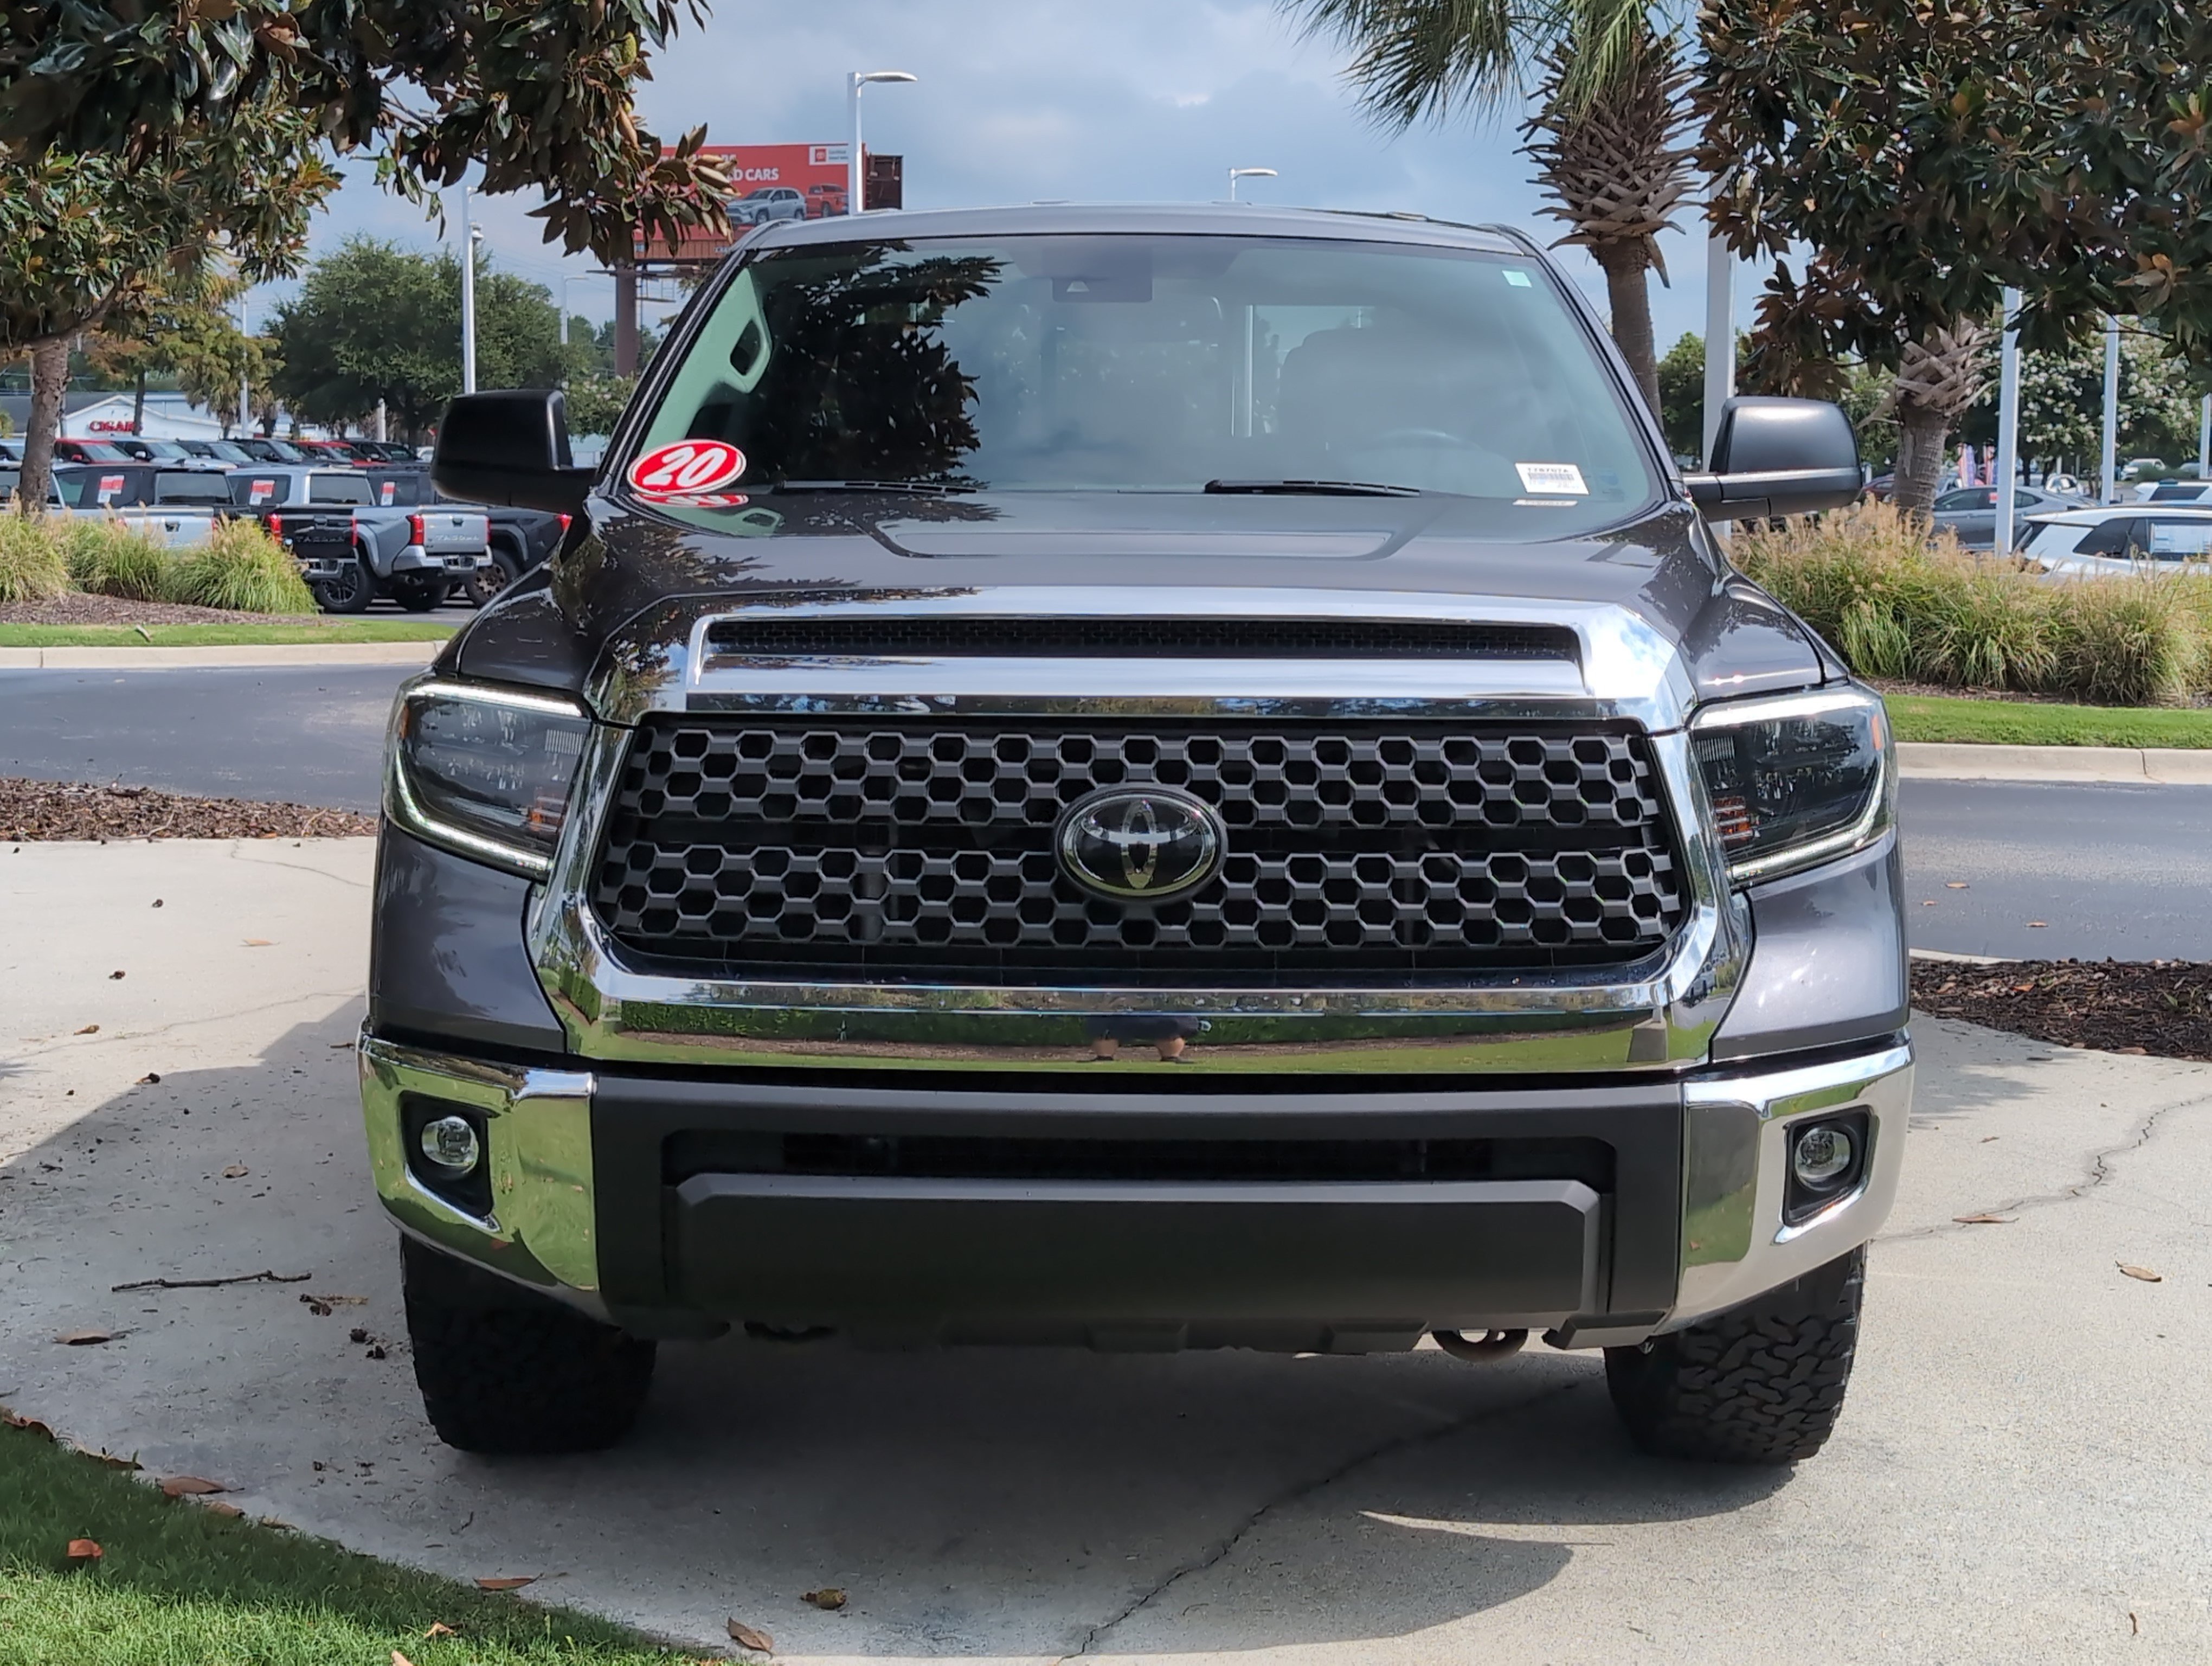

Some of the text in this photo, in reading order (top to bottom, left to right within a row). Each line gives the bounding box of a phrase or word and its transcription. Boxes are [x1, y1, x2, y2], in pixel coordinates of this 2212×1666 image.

[745, 167, 779, 181] CARS
[89, 421, 143, 431] CIGAR
[642, 446, 728, 488] 20
